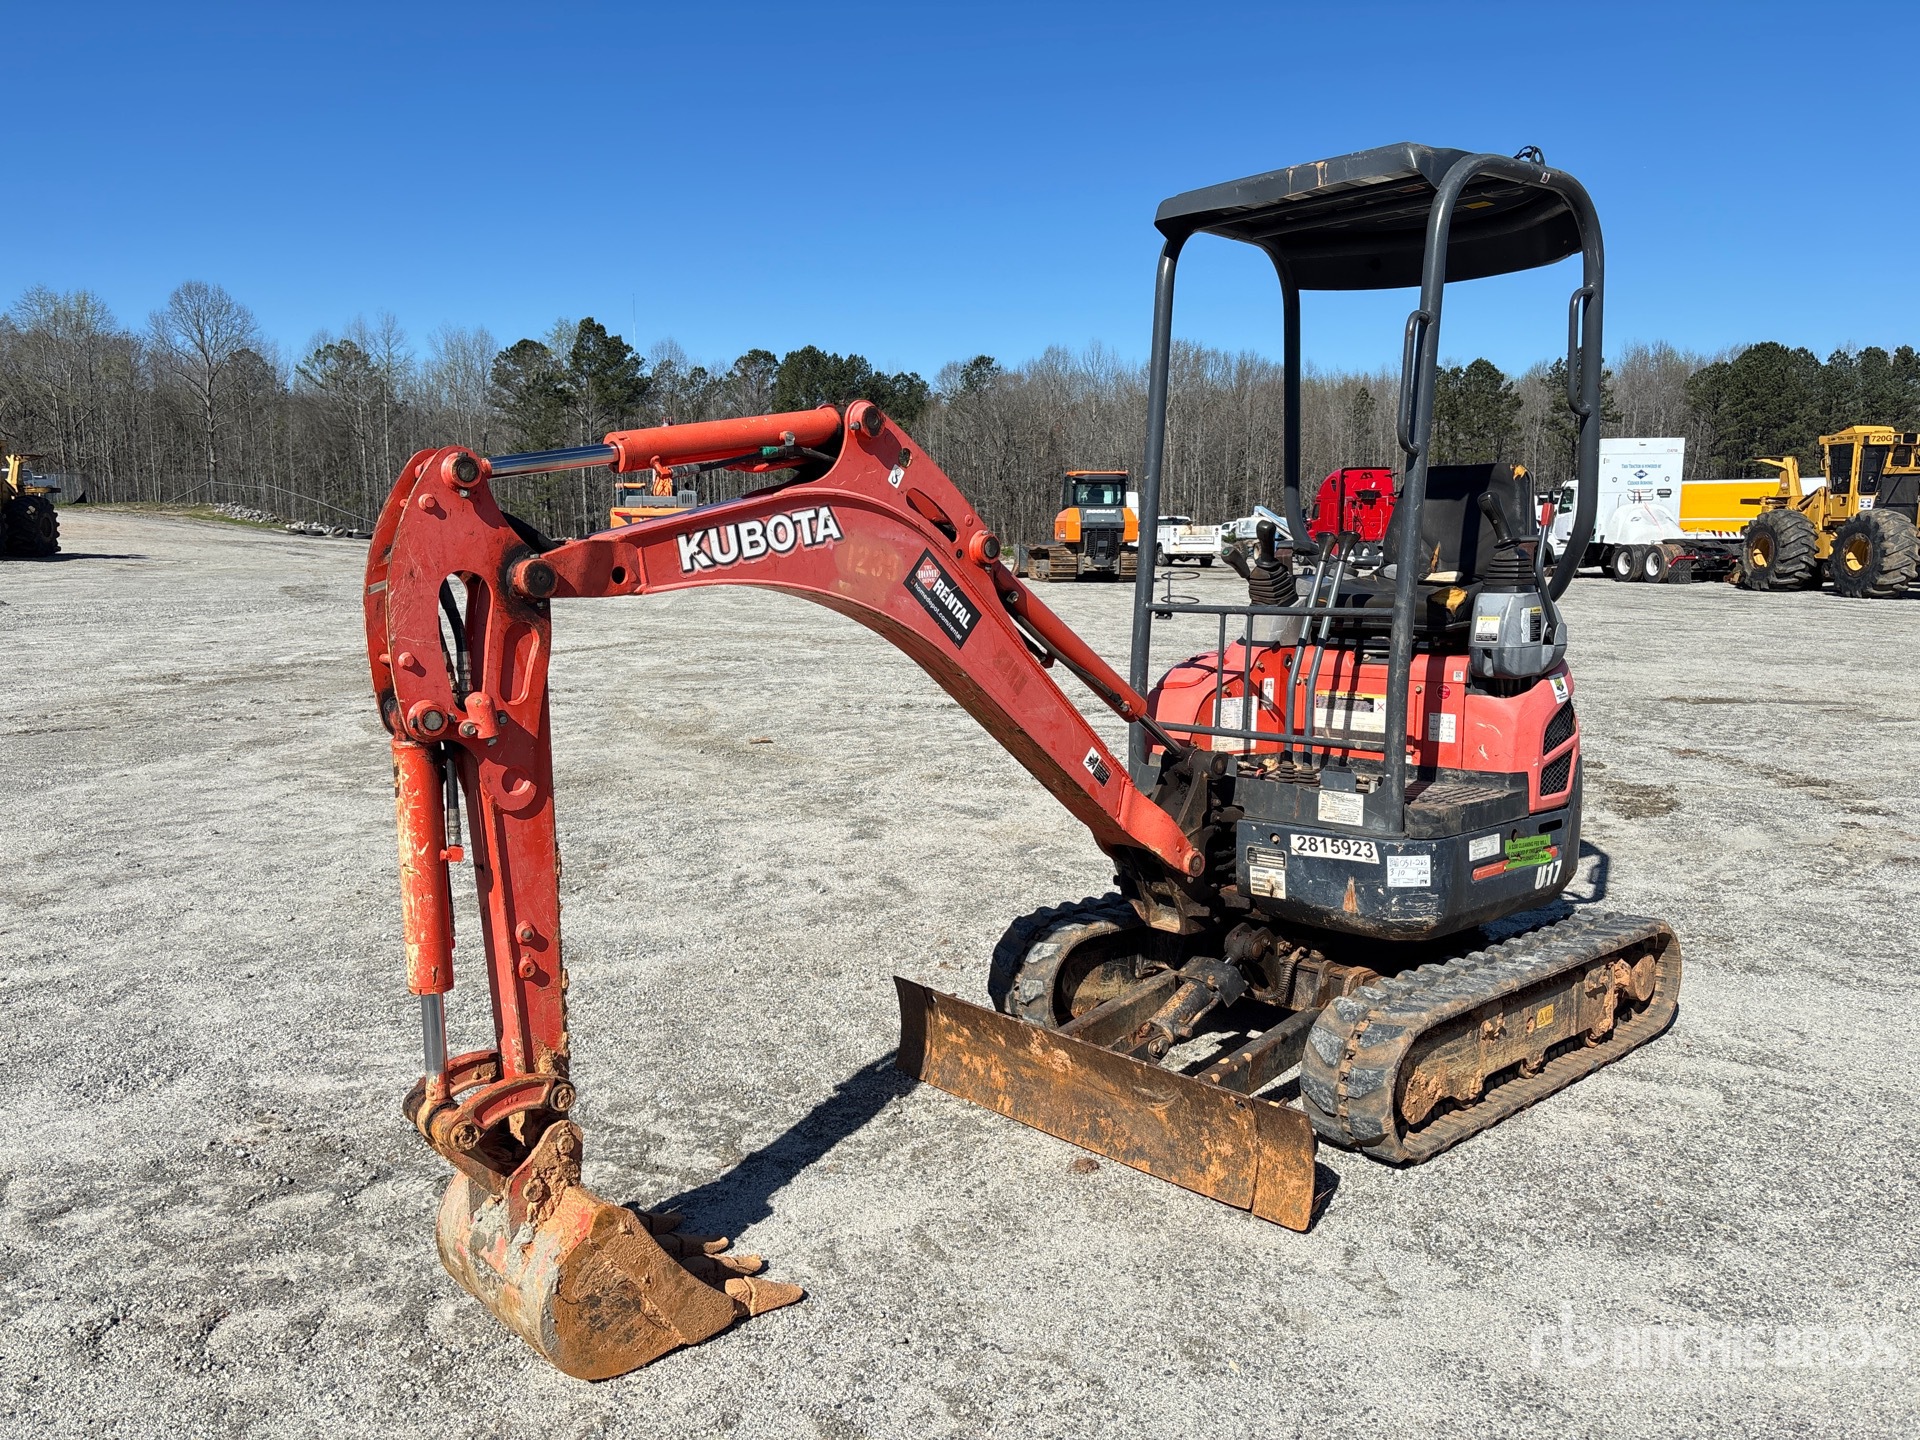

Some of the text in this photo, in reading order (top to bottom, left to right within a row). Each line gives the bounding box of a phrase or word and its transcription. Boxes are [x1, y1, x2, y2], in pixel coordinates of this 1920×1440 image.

[676, 505, 843, 572] KUBOTA
[918, 570, 938, 579] HOME
[914, 583, 962, 640] homedepot.com/rental
[932, 578, 971, 629] RENTAL
[1297, 836, 1374, 858] 2815923
[1519, 841, 1534, 849] CLEANING
[1535, 860, 1562, 889] U17
